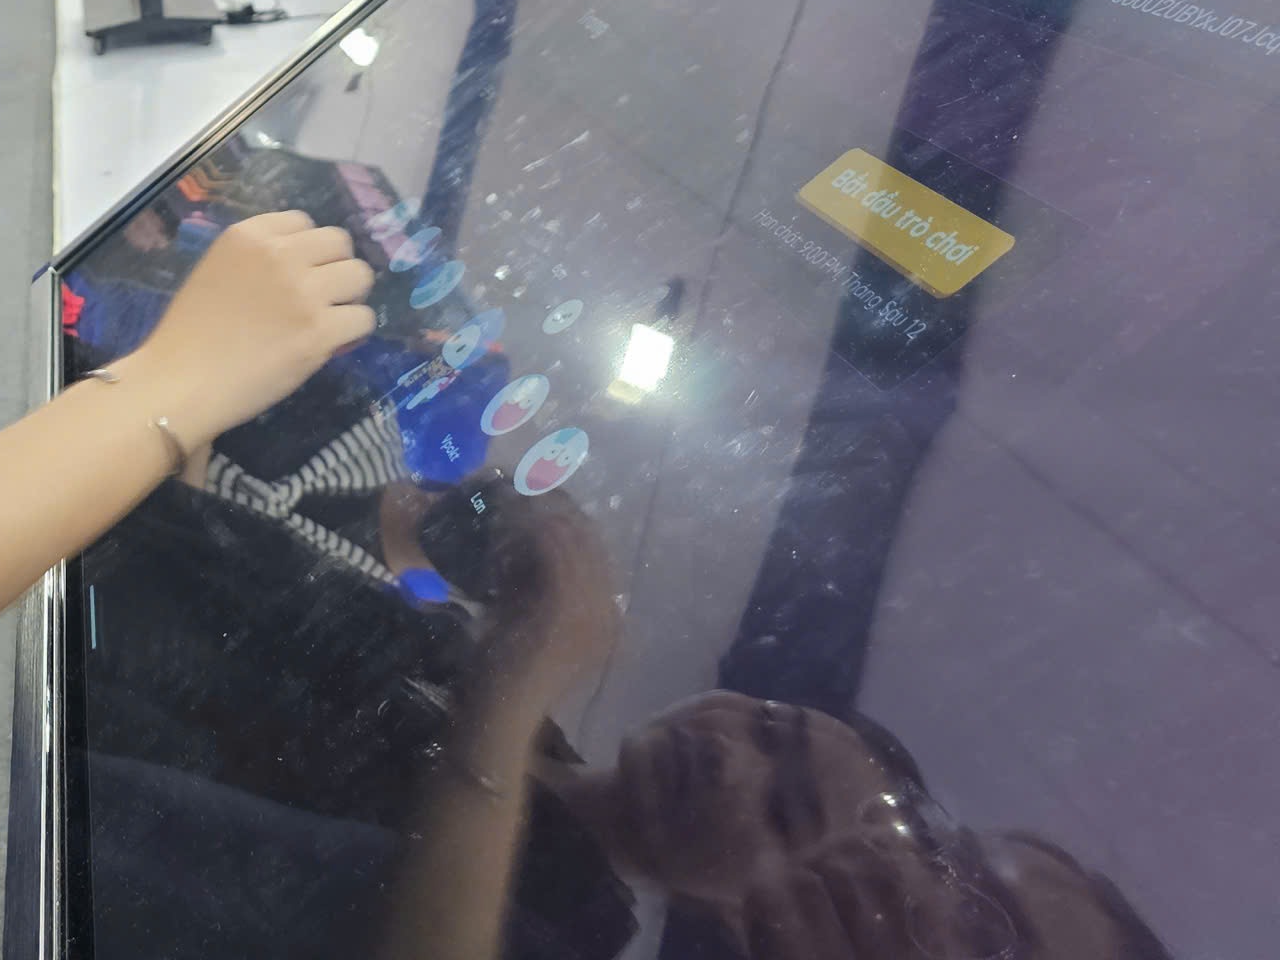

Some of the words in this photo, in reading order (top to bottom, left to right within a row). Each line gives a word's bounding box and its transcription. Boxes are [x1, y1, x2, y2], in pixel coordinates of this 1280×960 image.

[831, 168, 869, 198] Bắt
[861, 190, 903, 219] đầu
[895, 208, 934, 237] trò
[926, 231, 980, 265] chơi
[840, 271, 883, 311] Tháng
[470, 491, 487, 515] Lan
